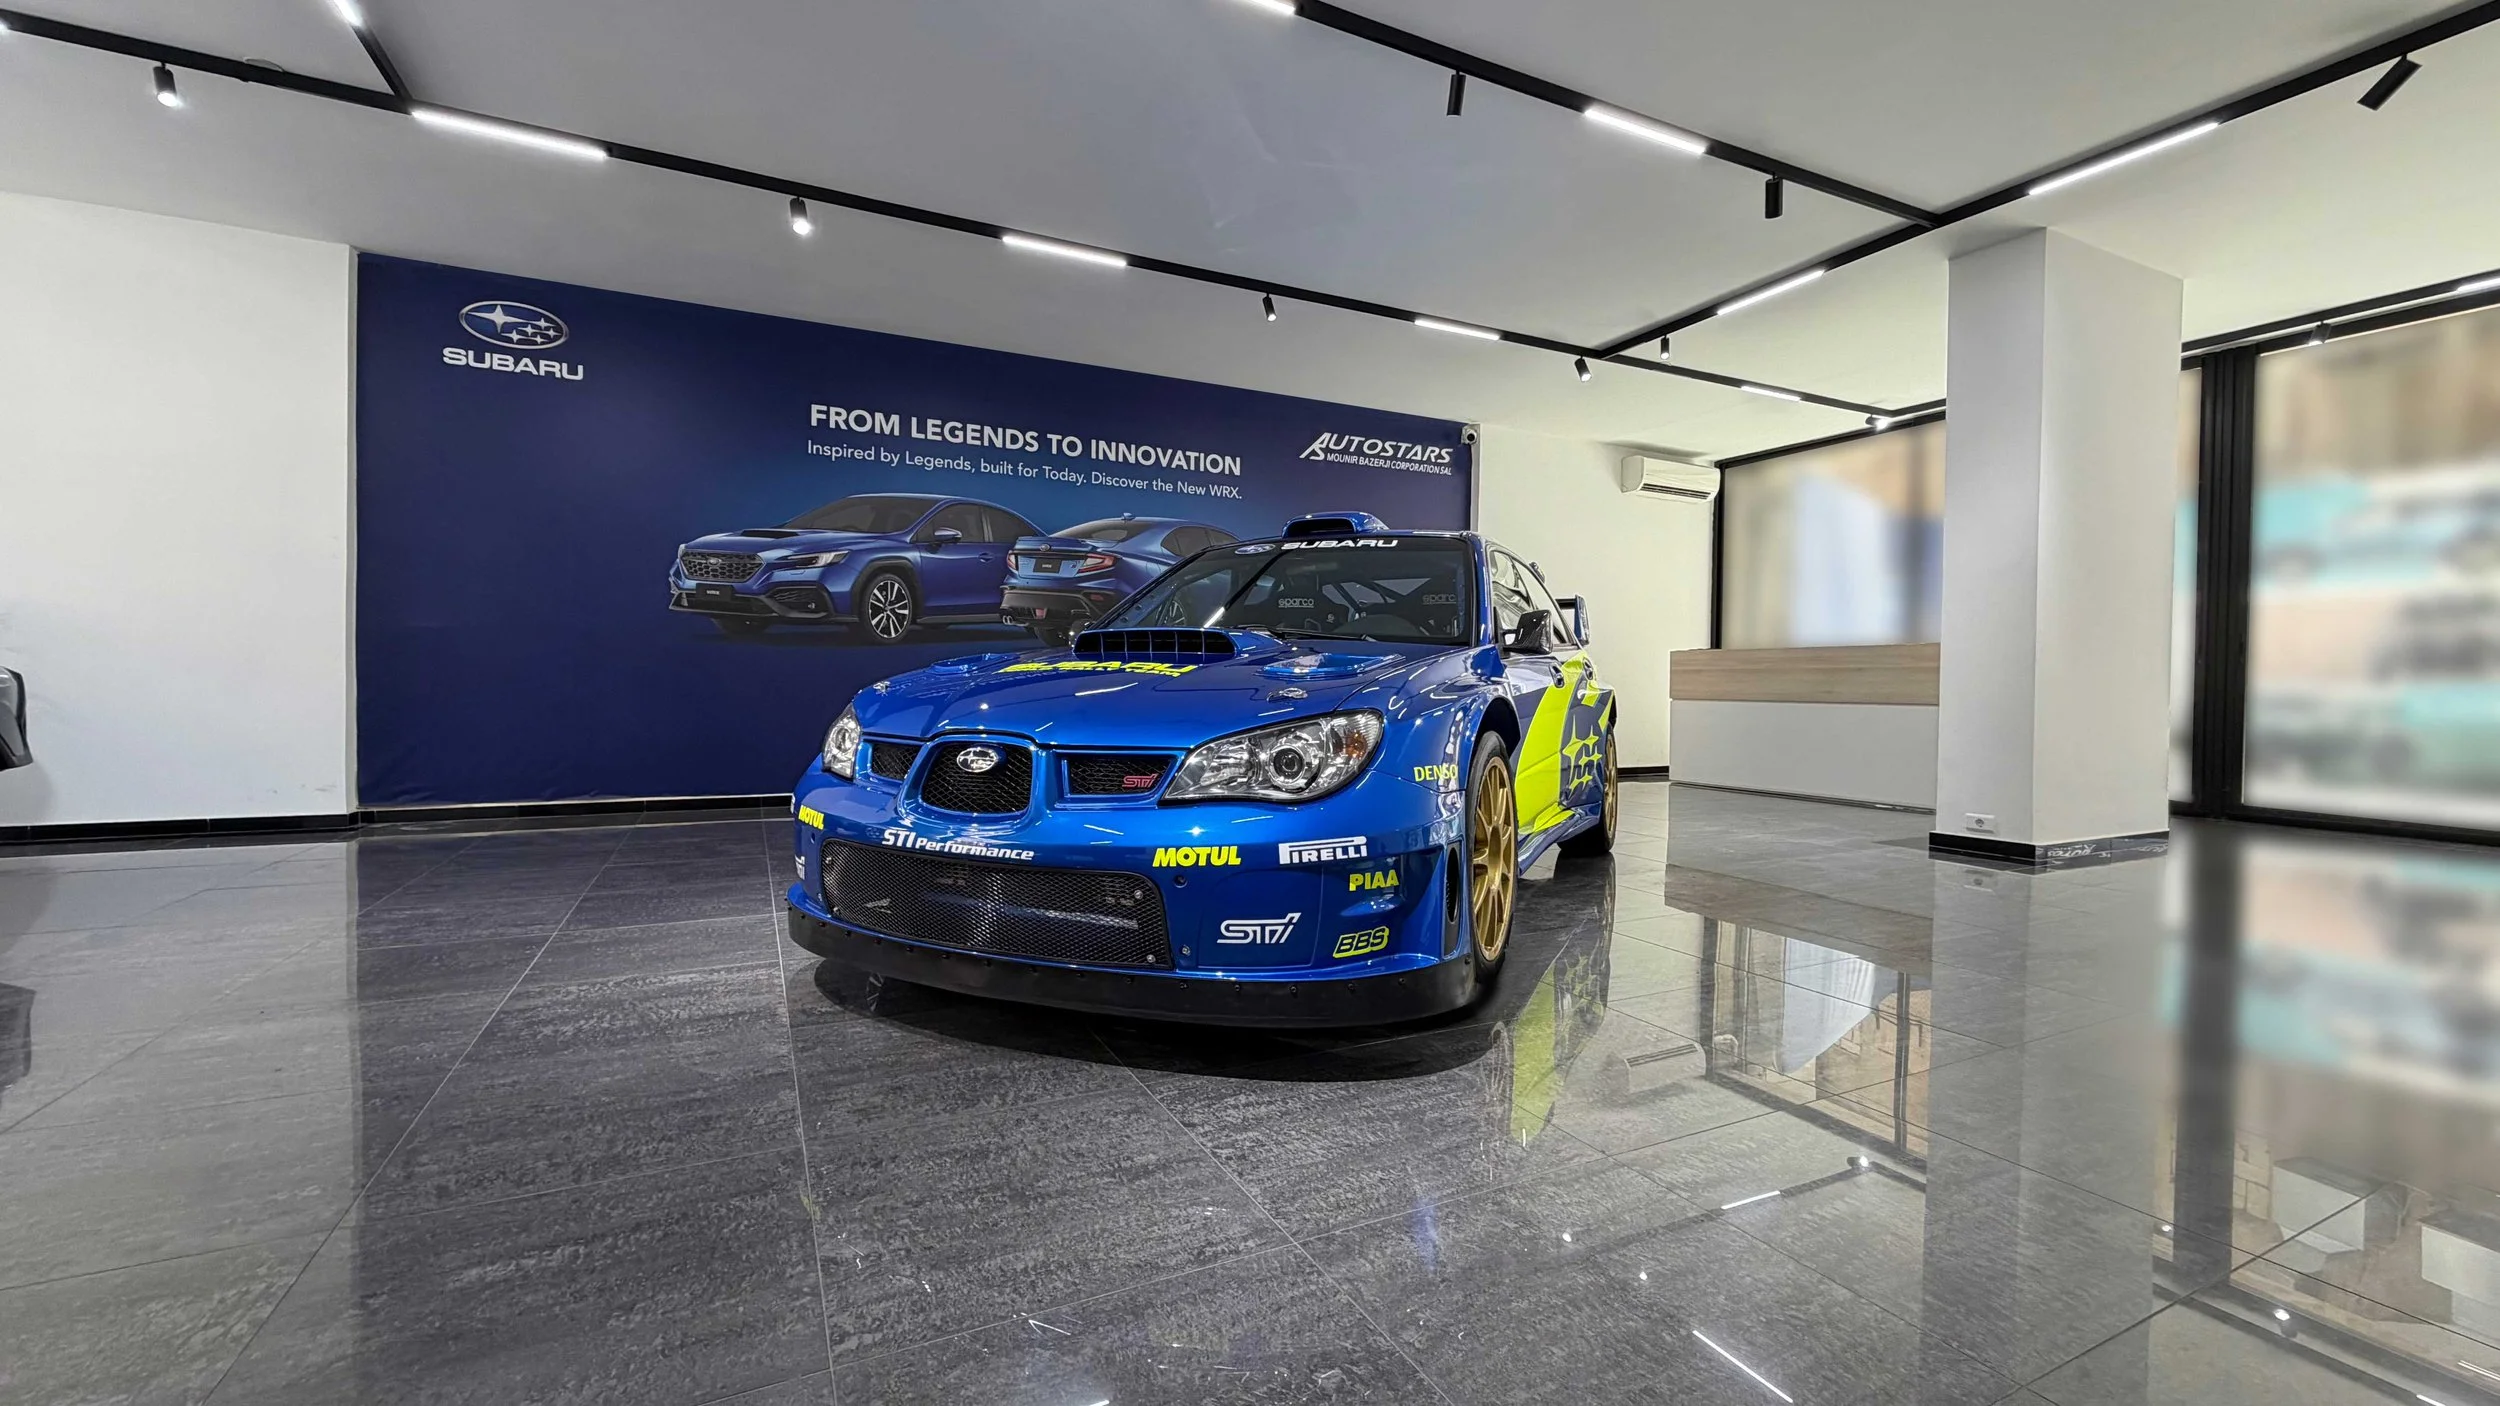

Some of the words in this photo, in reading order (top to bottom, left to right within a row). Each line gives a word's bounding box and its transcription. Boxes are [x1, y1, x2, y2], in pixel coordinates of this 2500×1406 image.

[442, 347, 584, 381] SUBARU
[810, 403, 900, 436] FROM
[911, 416, 1039, 453] LEGENDS
[1047, 433, 1083, 457] TO
[1090, 439, 1241, 476] INNOVATION
[1299, 432, 1454, 463] AUTOSTARS
[807, 440, 875, 461] Inspired
[880, 447, 900, 467] by
[905, 451, 976, 473] Legends,
[980, 458, 1014, 476] built
[1017, 462, 1038, 477] for
[1043, 466, 1087, 486] Today.
[1091, 472, 1148, 489] Discover
[1152, 479, 1173, 492] the
[1177, 481, 1206, 496] New
[1210, 485, 1243, 499] WRX.
[1326, 453, 1358, 464] MOUNIR
[1358, 457, 1391, 469] BAZERJI
[1391, 462, 1440, 474] CORPORATION
[1440, 467, 1452, 475] SAL
[1280, 539, 1399, 550] SUBARU
[1278, 598, 1315, 608] sparco
[1413, 763, 1458, 782] DENSO
[798, 805, 825, 830] MOTUL
[882, 828, 917, 848] STI
[915, 837, 1035, 861] Performance
[1152, 846, 1242, 867] MOTUL
[1278, 836, 1368, 865] PIRELLI
[1349, 869, 1400, 892] PIAA
[1334, 926, 1389, 958] BBS
